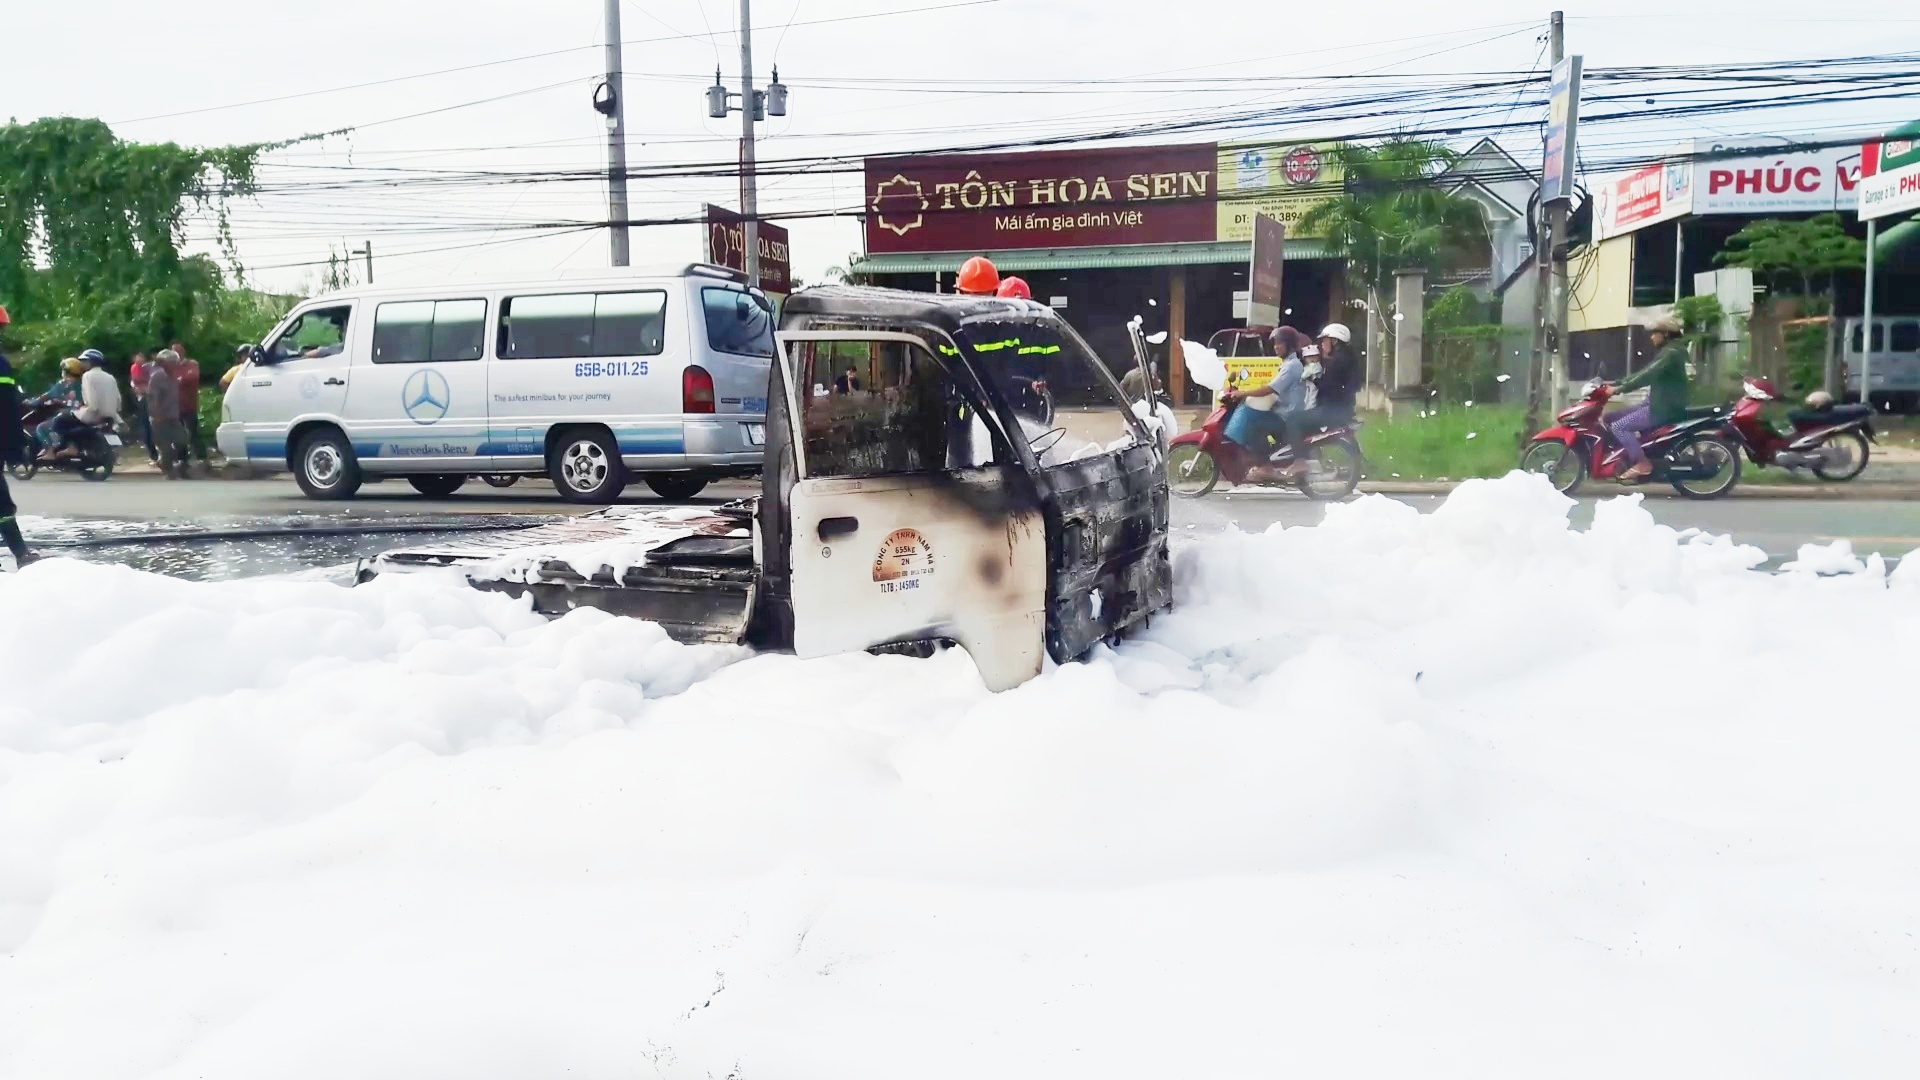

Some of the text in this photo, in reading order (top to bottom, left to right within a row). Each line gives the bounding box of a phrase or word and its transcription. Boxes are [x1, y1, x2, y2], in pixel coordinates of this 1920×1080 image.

[1709, 160, 1821, 195] PHÚC
[936, 170, 1210, 209] TÔN HOA SEN
[996, 210, 1143, 231] Mái ấm gia đình Việt
[757, 236, 770, 258] OA
[771, 241, 788, 262] SEN
[575, 361, 648, 377] 65B-011.25
[494, 392, 611, 402] The safest minibus for your journey
[917, 535, 930, 551] NAM
